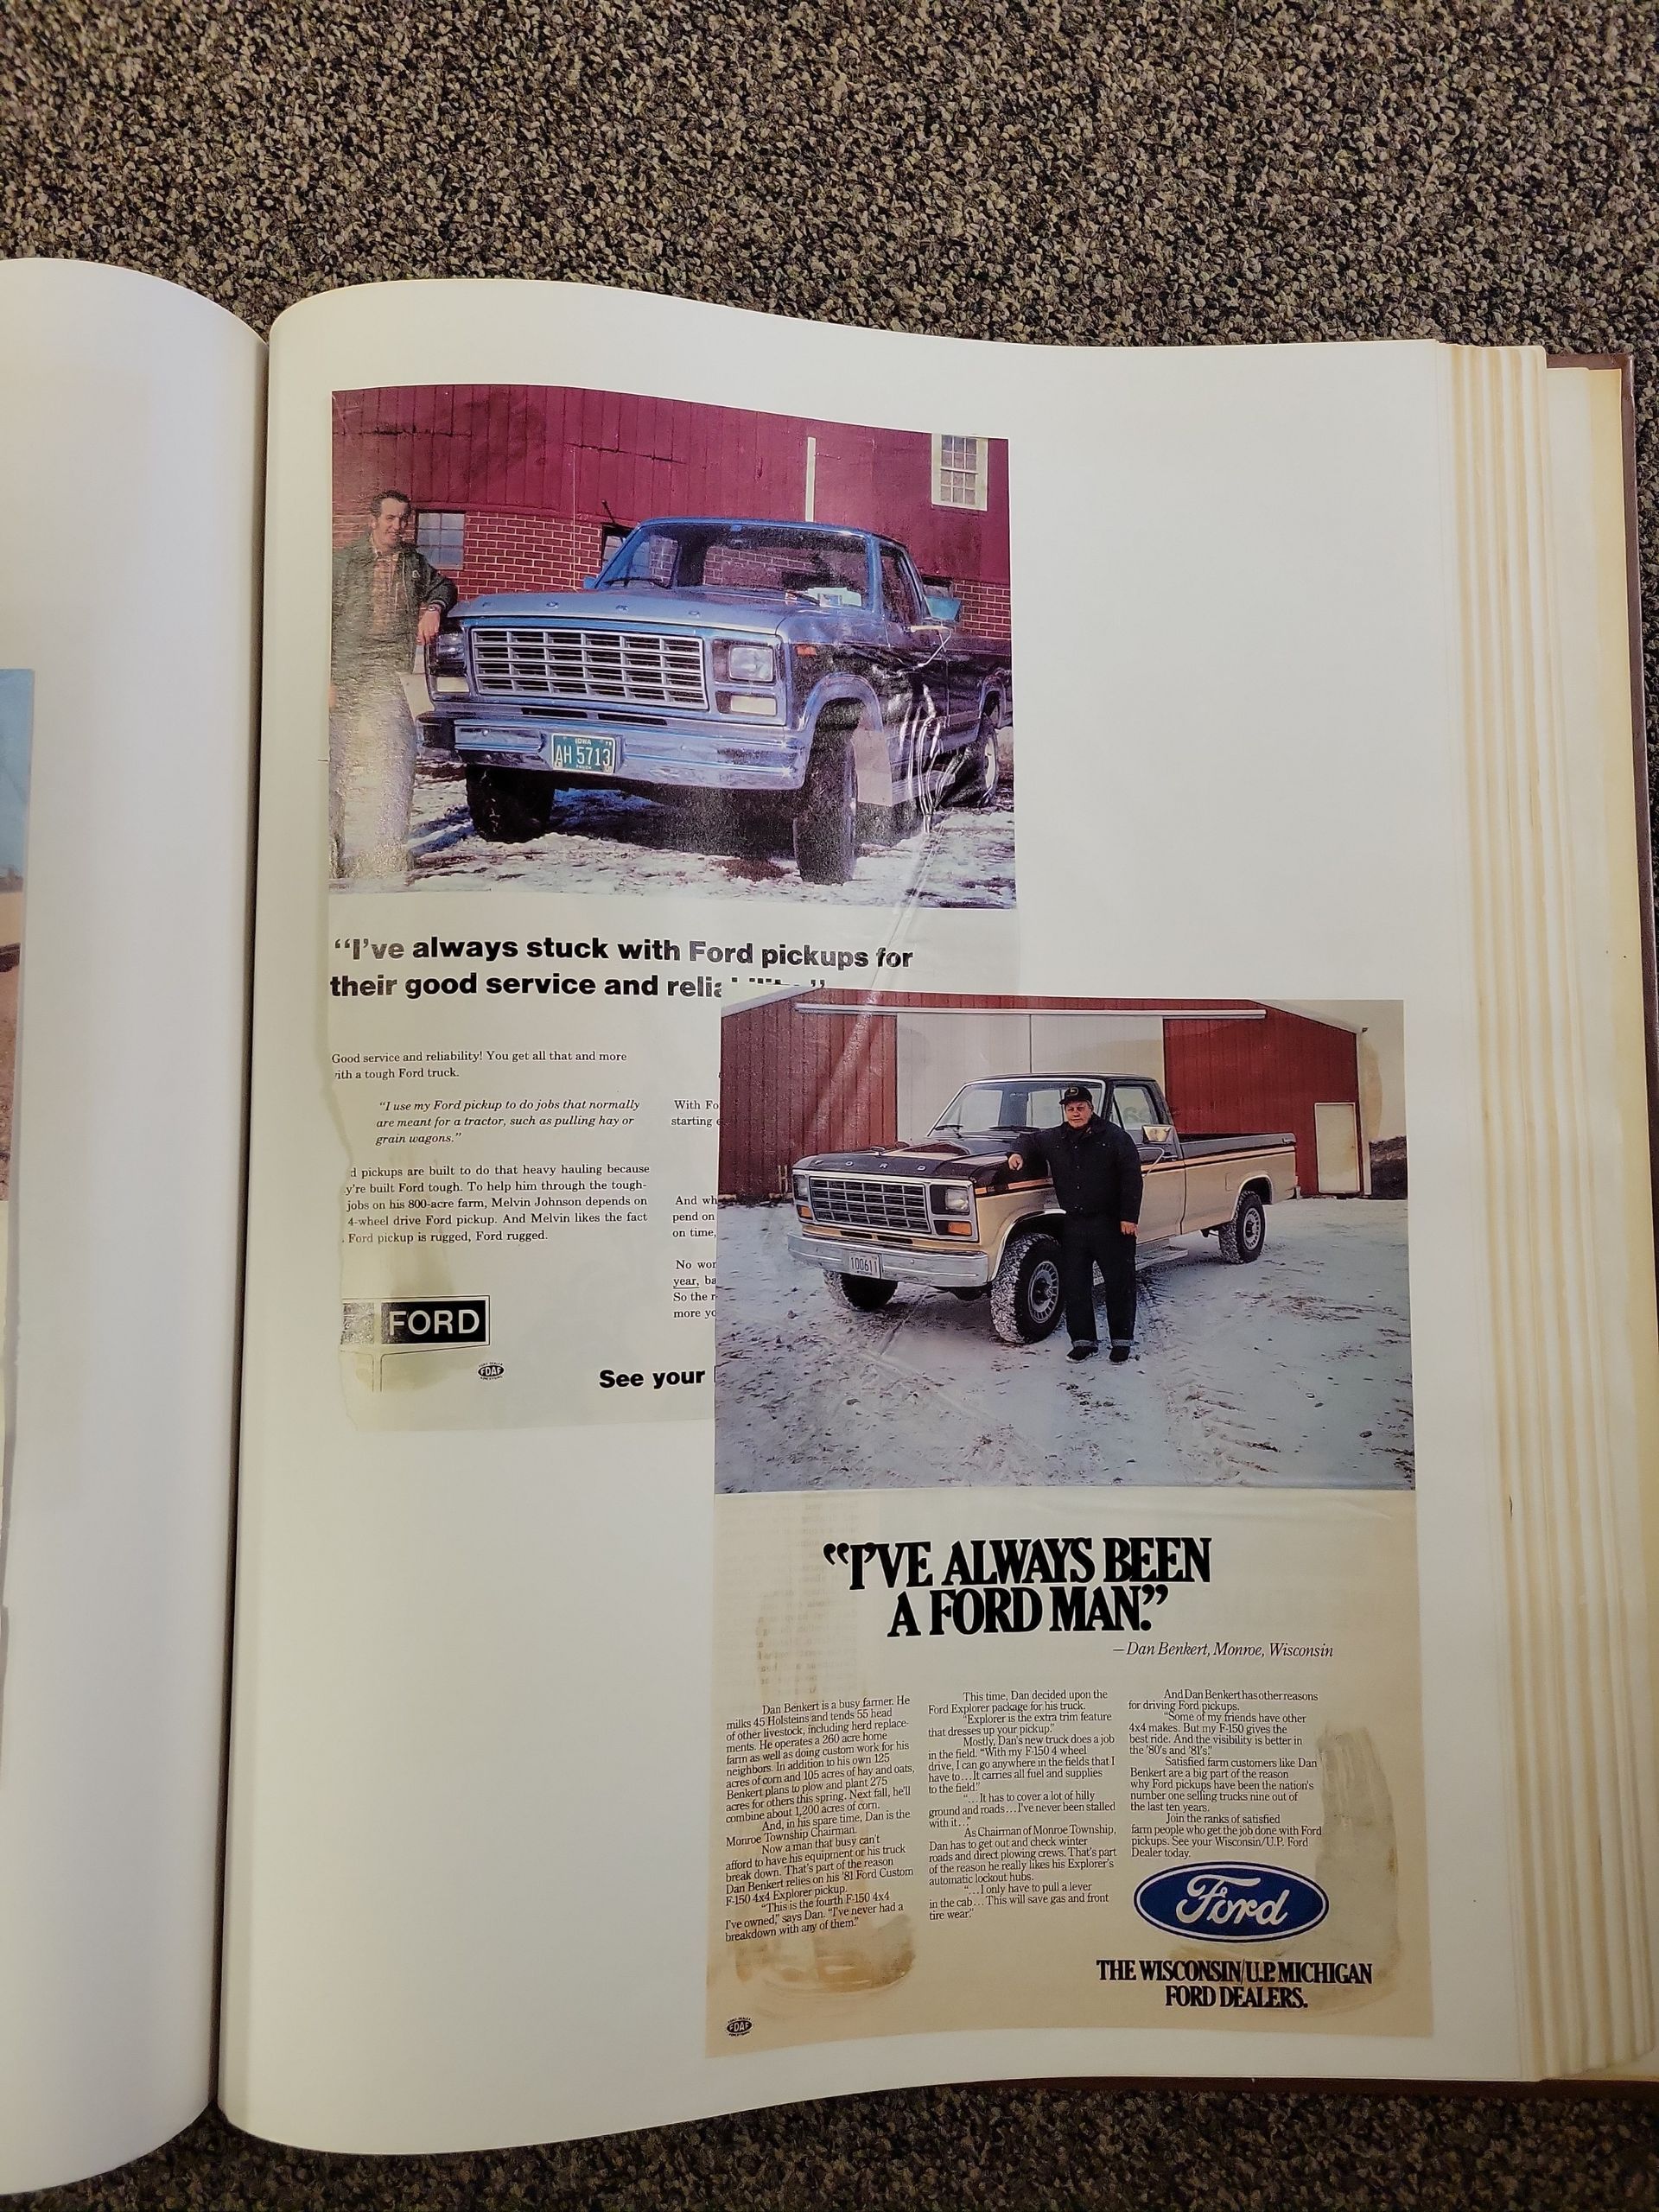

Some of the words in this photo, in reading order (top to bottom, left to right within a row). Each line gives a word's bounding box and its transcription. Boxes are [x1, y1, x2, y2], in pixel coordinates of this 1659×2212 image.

[556, 745, 571, 764] AH
[577, 747, 610, 766] 5713
[413, 937, 518, 961] always
[526, 938, 609, 959] stuck
[618, 939, 680, 961] with
[689, 941, 753, 963] Ford
[762, 944, 868, 968] pickups
[876, 948, 914, 968] for
[330, 976, 397, 996] their
[405, 973, 477, 998] good
[486, 973, 596, 995] service
[605, 976, 658, 996] and
[332, 1052, 359, 1063] Good
[363, 1052, 399, 1062] service
[403, 1051, 423, 1062] and
[425, 1051, 482, 1065] reliability!
[487, 1051, 509, 1061] You
[512, 1052, 529, 1065] get
[532, 1050, 545, 1061] all
[549, 1050, 572, 1061] that
[575, 1050, 595, 1061] and
[365, 1067, 395, 1082] tough
[398, 1066, 423, 1077] Ford
[427, 1066, 459, 1077] truck.
[413, 1103, 429, 1114] my
[433, 1099, 461, 1109] Ford
[463, 1099, 501, 1113] pickup
[505, 1100, 515, 1109] to
[518, 1098, 533, 1109] do
[536, 1098, 560, 1113] jobs
[562, 1098, 586, 1109] that
[588, 1098, 639, 1112] normally
[674, 1100, 700, 1109] With
[671, 1116, 712, 1128] starting
[376, 1132, 405, 1147] grain
[361, 1165, 403, 1179] pickups
[429, 1164, 454, 1175] built
[460, 1166, 471, 1175] to
[475, 1164, 489, 1175] do
[494, 1164, 518, 1174] that
[522, 1164, 556, 1178] heavy
[561, 1163, 602, 1177] hauling
[607, 1163, 649, 1173] because
[346, 1198, 369, 1212] jobs
[389, 1198, 404, 1209] his
[408, 1198, 454, 1208] 800-acre
[457, 1197, 486, 1210] farm,
[491, 1196, 531, 1207] Melvin
[534, 1196, 582, 1207] Johnson
[585, 1195, 630, 1210] depends
[676, 1196, 696, 1205] And
[672, 1211, 698, 1224] pend
[348, 1232, 372, 1243] Ford
[378, 1231, 413, 1246] pickup
[417, 1231, 426, 1242] is
[430, 1230, 471, 1245] rugged,
[475, 1230, 503, 1241] Ford
[506, 1230, 548, 1243] rugged.
[690, 1228, 716, 1237] time,
[676, 1260, 691, 1269] No
[674, 1293, 686, 1301] So
[691, 1293, 707, 1301] the
[389, 1310, 479, 1336] FORD
[600, 1370, 644, 1388] See
[653, 1370, 705, 1388] your
[942, 1538, 1094, 1588] ALWAYS
[1103, 1538, 1211, 1584] BEEN
[887, 1592, 921, 1637] A
[930, 1589, 1043, 1636] FORD
[1158, 1643, 1210, 1660] Benkert,
[1214, 1643, 1264, 1660] Monroe,
[1268, 1644, 1334, 1658] Wisconsin
[963, 1691, 983, 1701] This
[985, 1690, 1007, 1702] time,
[1011, 1690, 1029, 1700] Dan
[1031, 1689, 1066, 1700] decided
[1068, 1692, 1090, 1702] upon
[1093, 1688, 1108, 1699] the
[763, 1705, 780, 1714] Dan
[784, 1701, 819, 1713] Benkert
[821, 1700, 829, 1711] is
[839, 1700, 860, 1711] busy
[862, 1698, 893, 1707] farmer.
[897, 1695, 910, 1706] He
[1128, 1700, 1141, 1709] for
[1142, 1700, 1176, 1713] driving
[1178, 1700, 1198, 1710] Ford
[1201, 1700, 1240, 1713] pickups.
[727, 1718, 751, 1729] milks
[753, 1716, 766, 1726] 45
[767, 1713, 809, 1725] Holsteins
[810, 1711, 828, 1721] and
[830, 1710, 855, 1720] tends
[856, 1708, 868, 1719] 55
[870, 1707, 892, 1718] head
[1196, 1711, 1205, 1721] of
[1207, 1714, 1222, 1725] my
[1224, 1712, 1256, 1722] friends
[1258, 1712, 1280, 1722] have
[1281, 1713, 1306, 1722] other
[726, 1835, 761, 1847] Monroe
[763, 1829, 808, 1842] Township
[810, 1827, 856, 1839] Chairman.
[1132, 1835, 1169, 1848] pickups.
[1172, 1835, 1189, 1846] See
[1191, 1839, 1212, 1849] your
[1287, 1837, 1308, 1847] Ford
[1132, 1847, 1162, 1857] Dealer
[1164, 1847, 1191, 1860] today.
[929, 1873, 973, 1885] automatic
[975, 1872, 1007, 1883] lockout
[1009, 1871, 1033, 1881] hubs.
[1176, 1873, 1290, 1925] Ford
[930, 1910, 944, 1920] tire
[726, 1928, 776, 1942] breakdown
[779, 1923, 798, 1935] with
[801, 1924, 817, 1935] any
[819, 1921, 828, 1931] of
[1096, 1960, 1136, 1980] THE
[1278, 1963, 1372, 1984] MICHIGAN
[1166, 1986, 1216, 2006] FORD
[1219, 1987, 1308, 2008] DEALERS.
